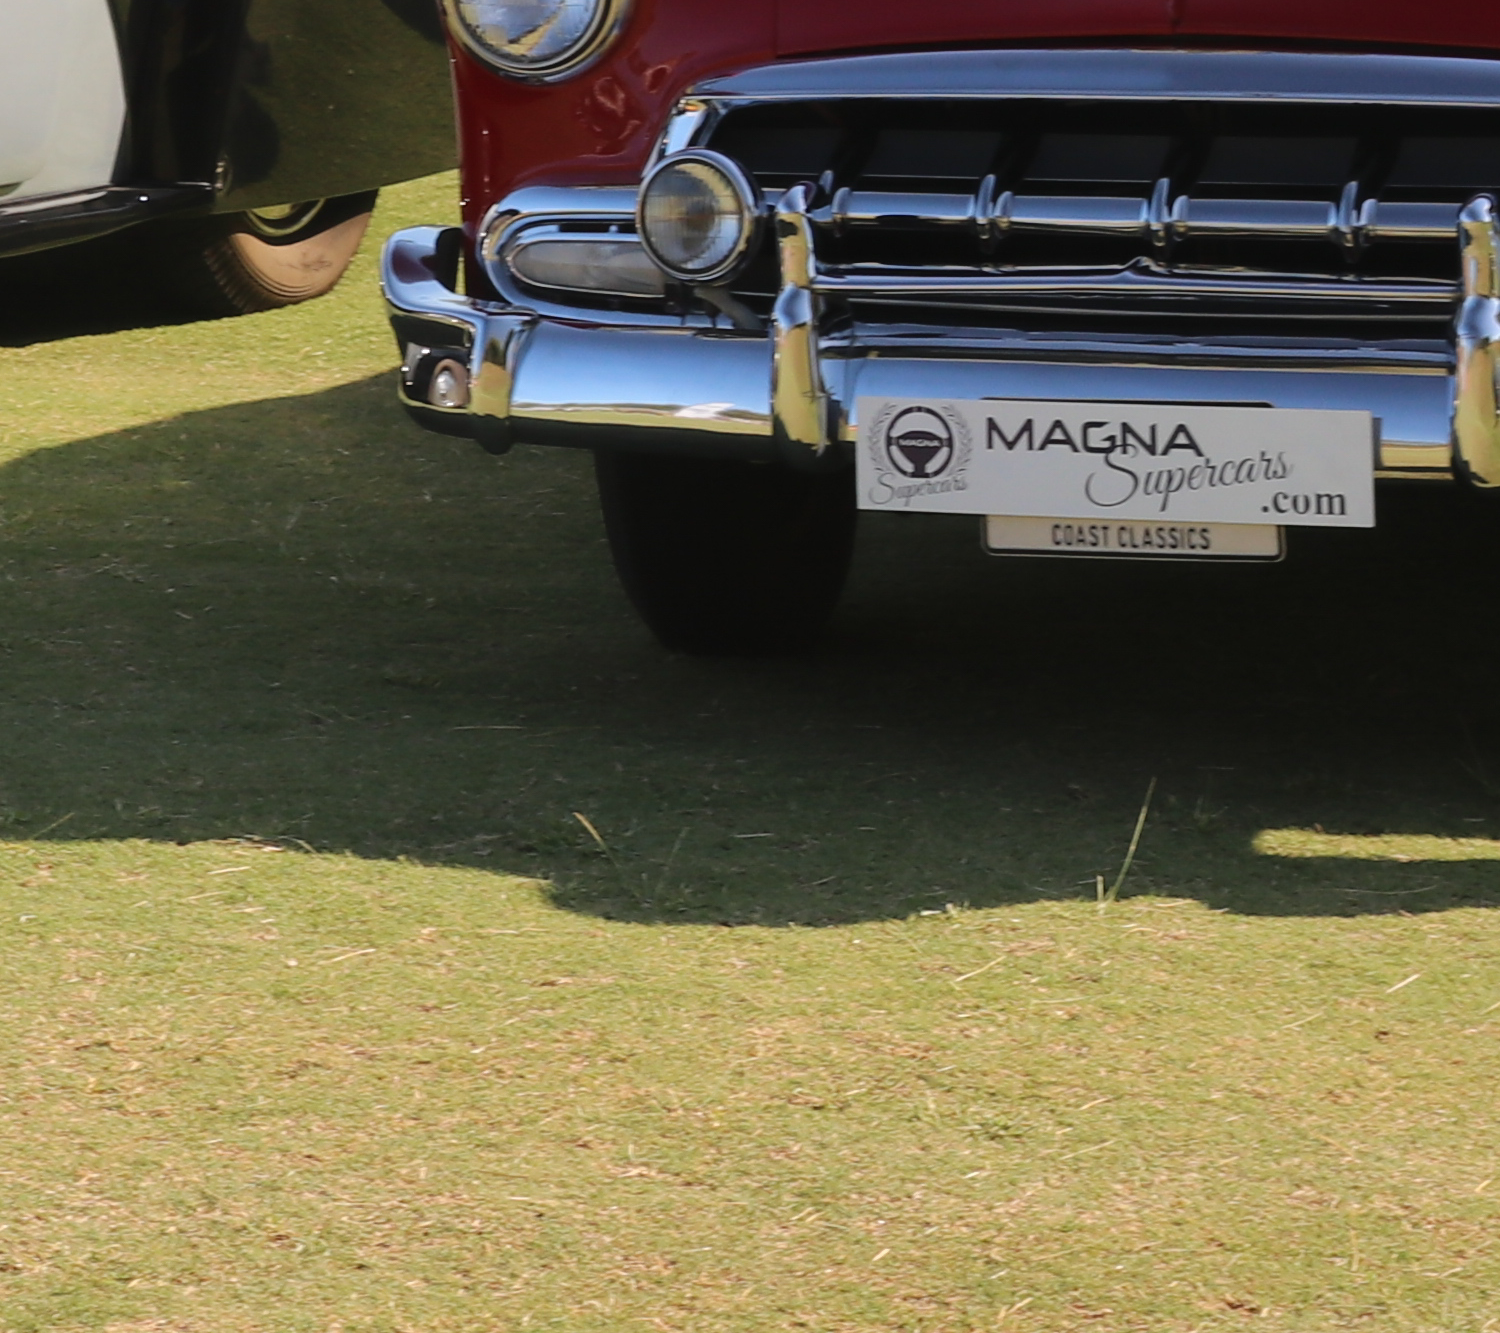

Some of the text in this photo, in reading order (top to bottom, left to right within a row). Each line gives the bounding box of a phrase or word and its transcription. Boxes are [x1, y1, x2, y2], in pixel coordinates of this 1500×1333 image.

[985, 416, 1205, 457] MAGNA
[1085, 442, 1296, 512] Supercars
[1259, 490, 1348, 517] .com
[1051, 523, 1212, 551] COAST CLASSICS
